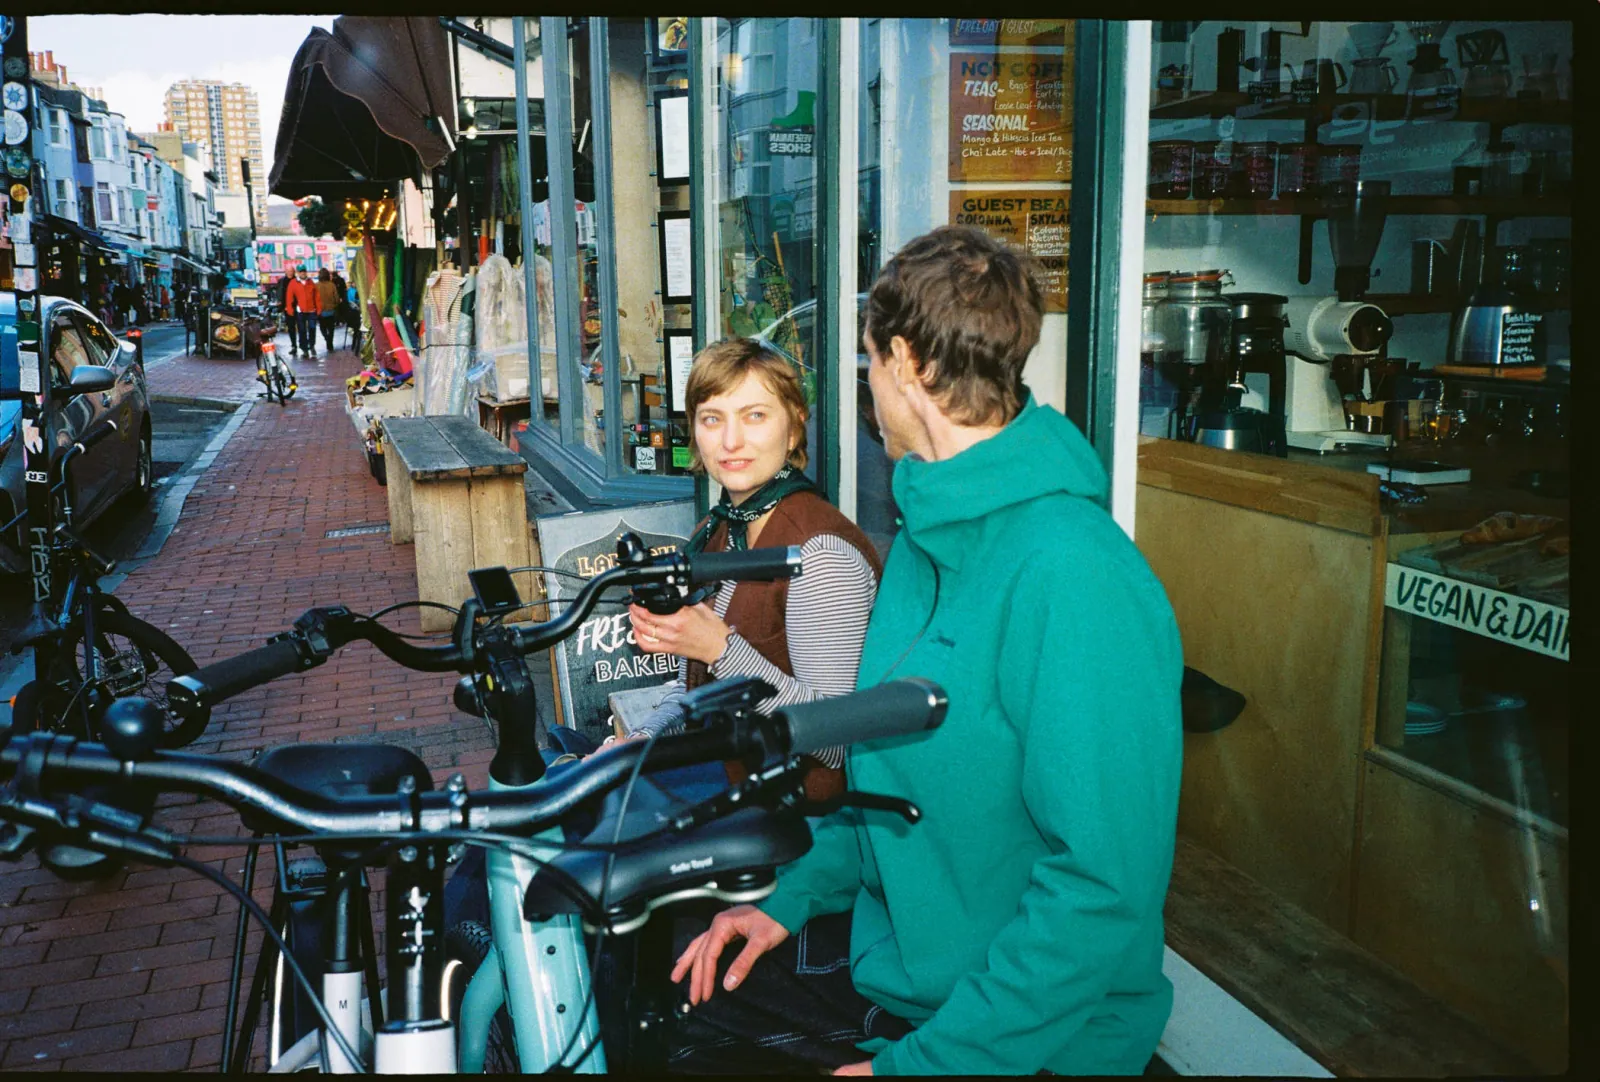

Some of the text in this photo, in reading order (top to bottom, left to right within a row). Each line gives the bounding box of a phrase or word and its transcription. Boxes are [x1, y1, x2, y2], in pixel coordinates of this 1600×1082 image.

[961, 61, 1004, 77] NOT
[962, 133, 991, 145] Mango
[992, 132, 1000, 143] &
[961, 147, 983, 157] Chai
[962, 198, 1071, 212] GUEST BEA
[1397, 571, 1486, 628] VEGAN
[1486, 596, 1508, 637] &
[339, 1000, 348, 1010] M
